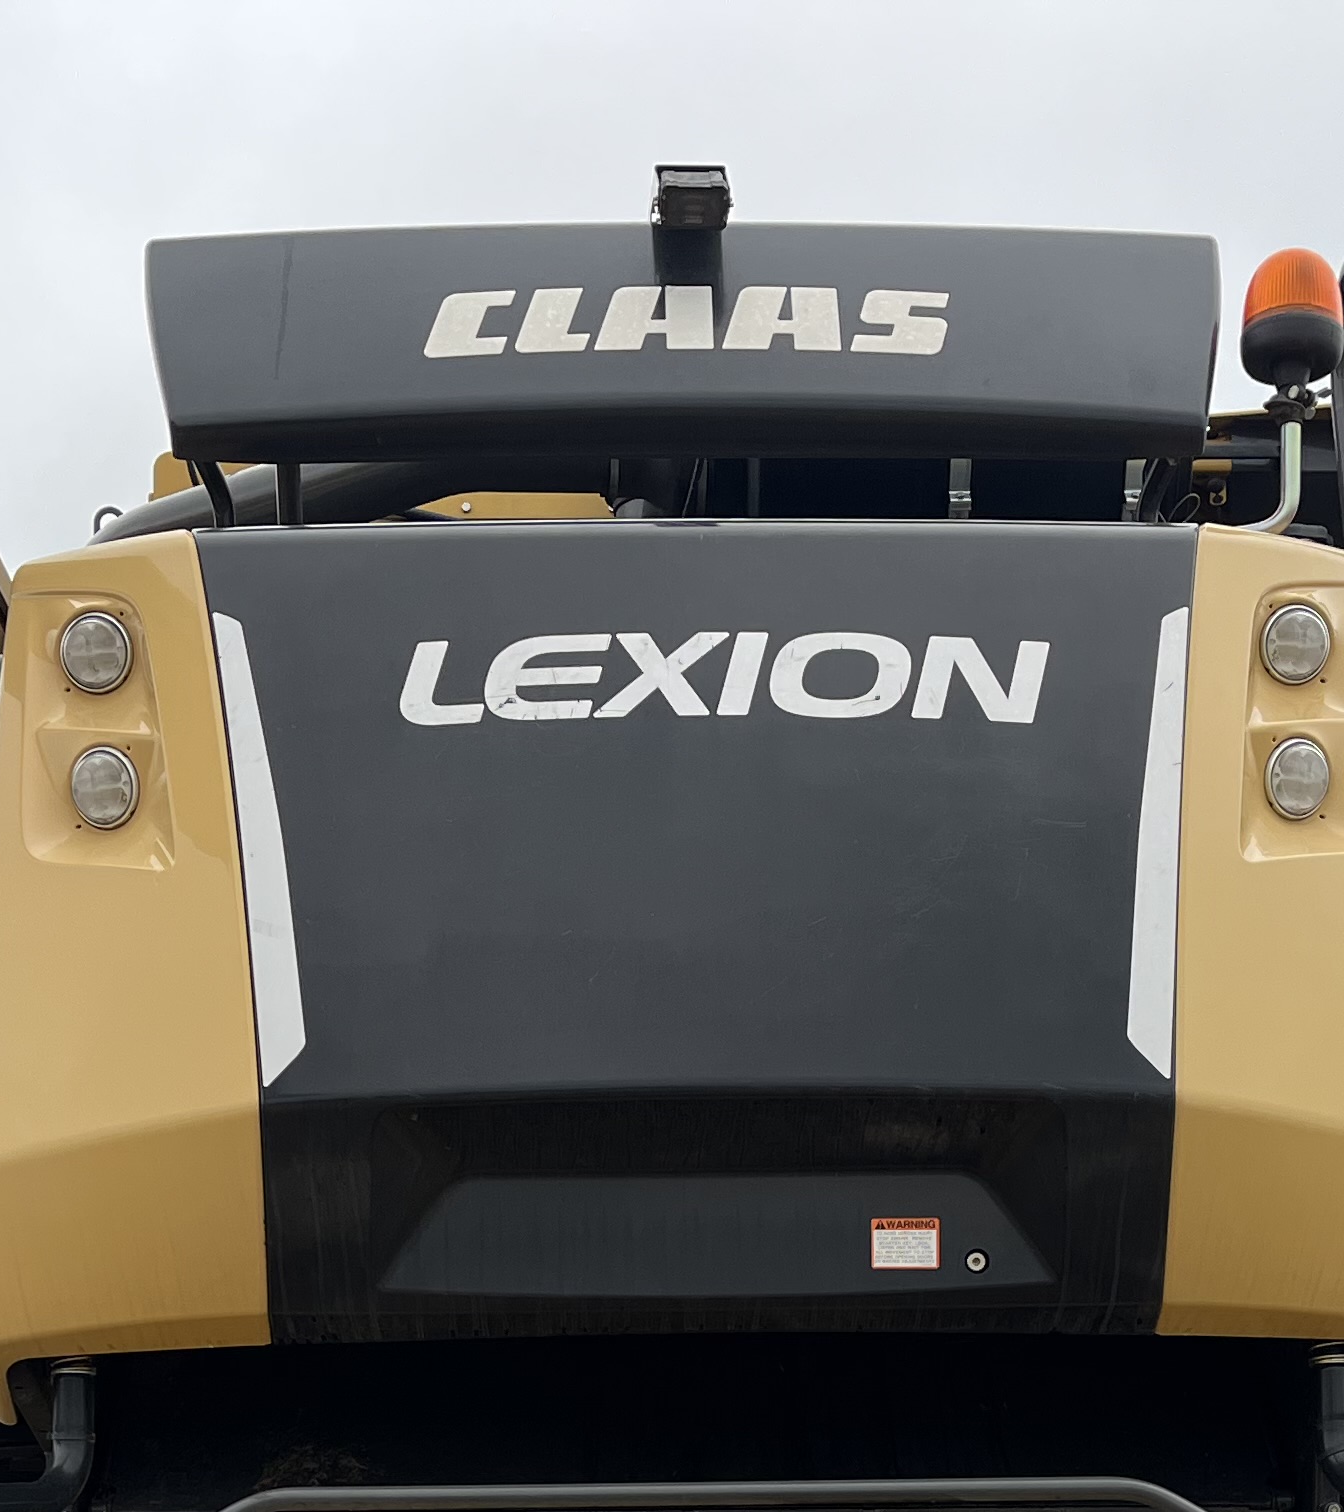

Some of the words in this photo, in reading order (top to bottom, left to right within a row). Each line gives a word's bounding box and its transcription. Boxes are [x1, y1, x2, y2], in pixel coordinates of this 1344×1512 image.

[423, 284, 950, 358] CLAAS
[399, 631, 1051, 726] LEXION
[886, 1219, 936, 1229] WARNING
